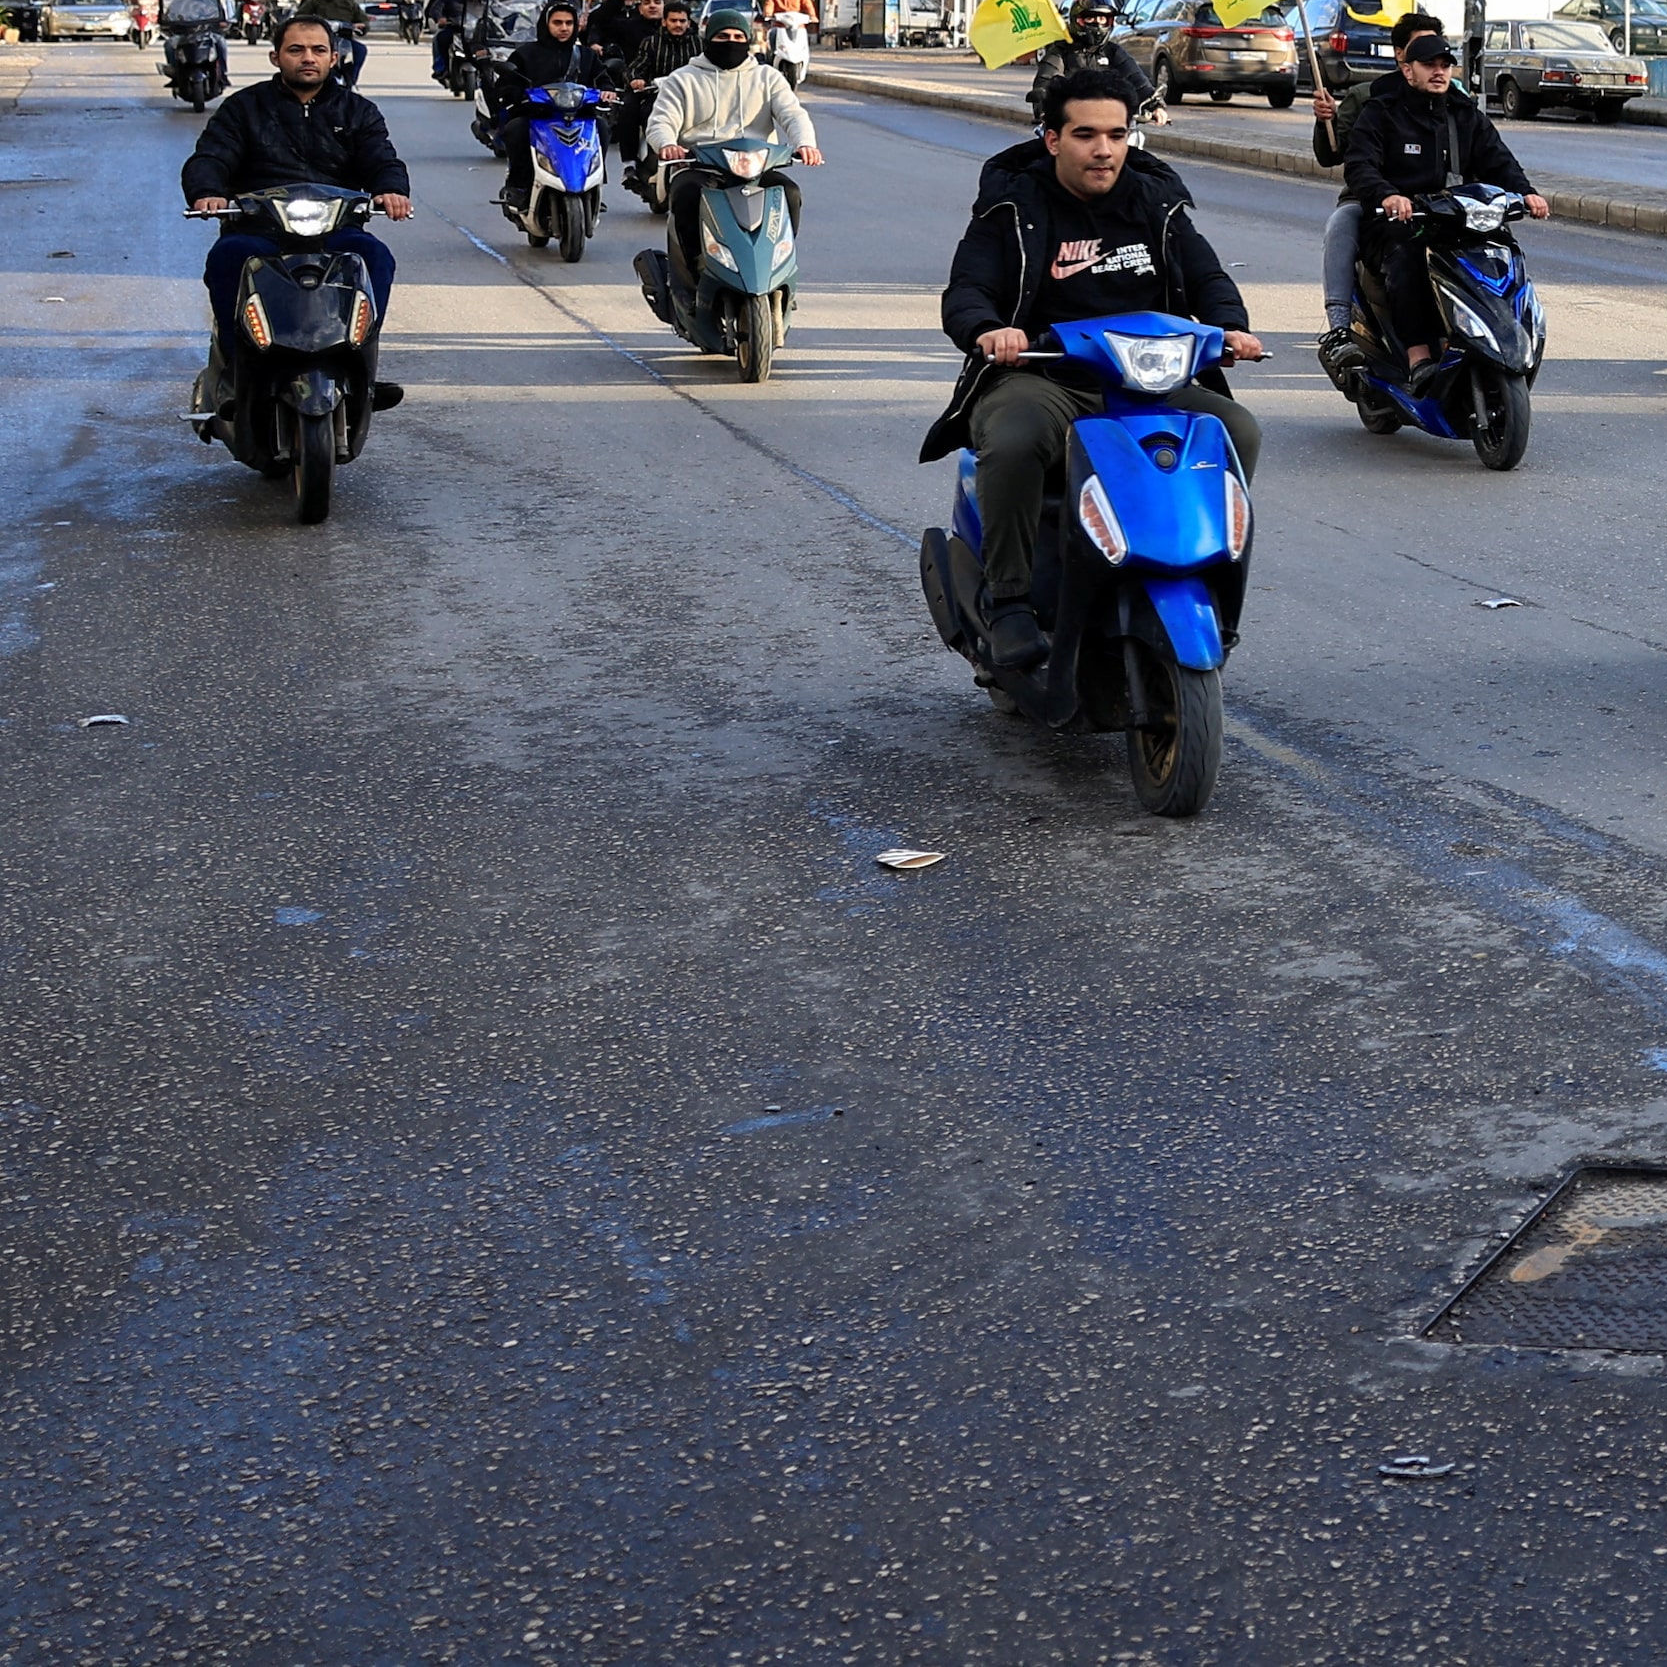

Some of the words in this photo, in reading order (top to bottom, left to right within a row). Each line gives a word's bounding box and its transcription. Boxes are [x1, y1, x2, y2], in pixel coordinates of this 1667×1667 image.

[1057, 238, 1103, 262] NIKE
[1091, 263, 1122, 274] BEACH
[1123, 257, 1151, 268] CREW
